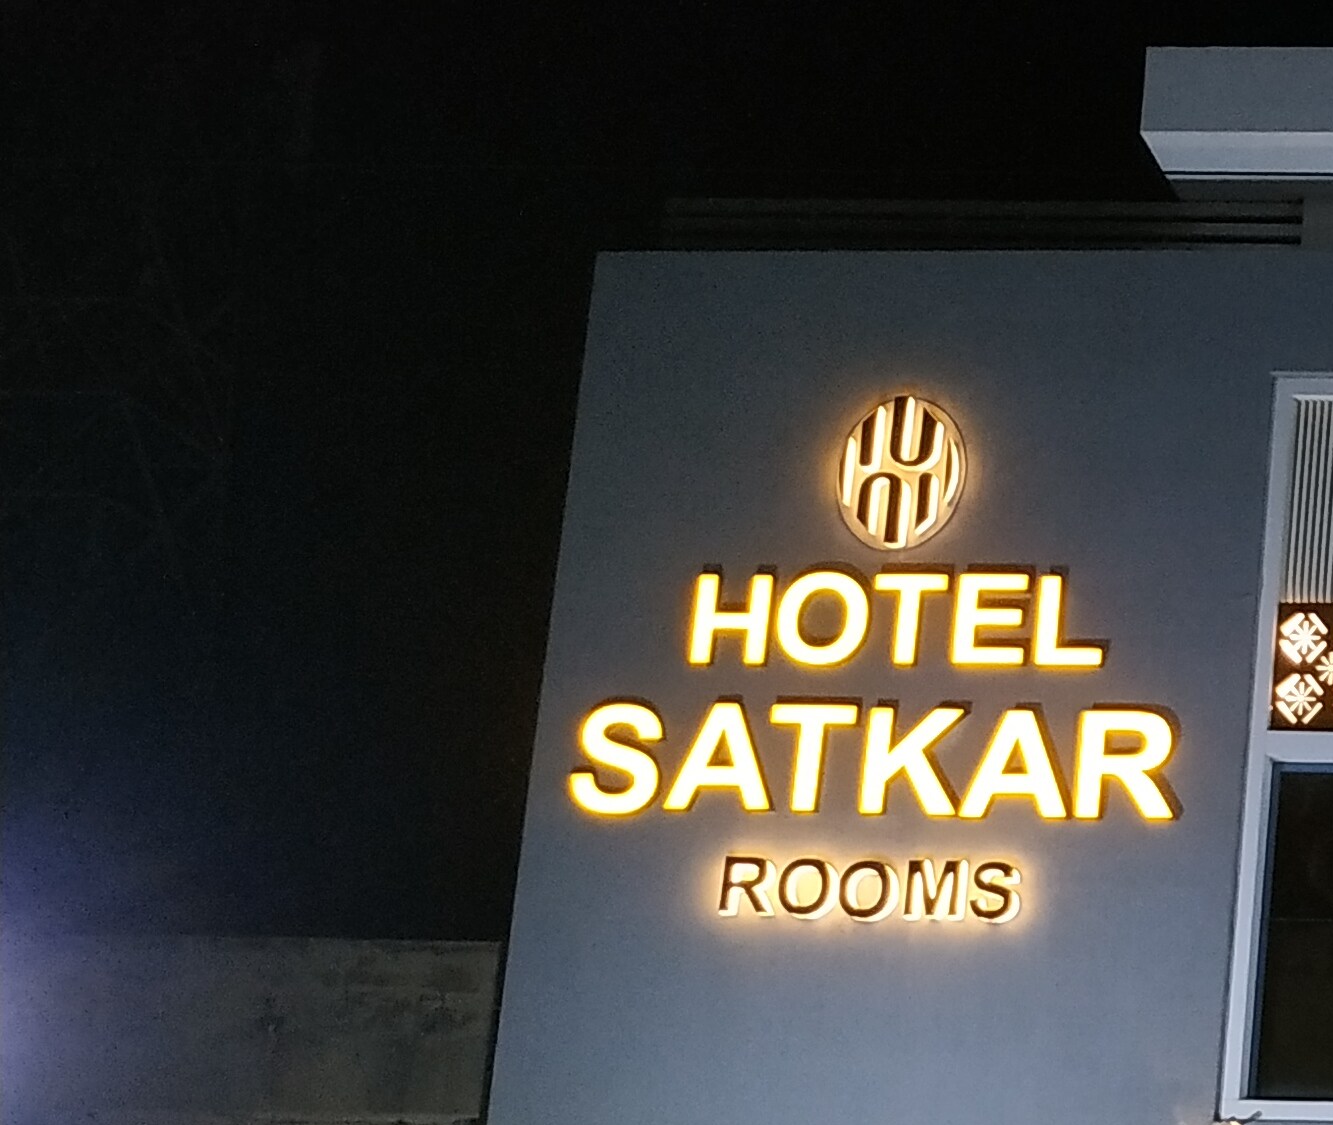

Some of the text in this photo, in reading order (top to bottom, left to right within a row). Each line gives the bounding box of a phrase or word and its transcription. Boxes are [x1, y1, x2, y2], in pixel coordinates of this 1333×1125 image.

[688, 568, 1106, 668] HOTEL
[568, 699, 1180, 822] SATKAR
[718, 854, 1022, 922] ROOMS
